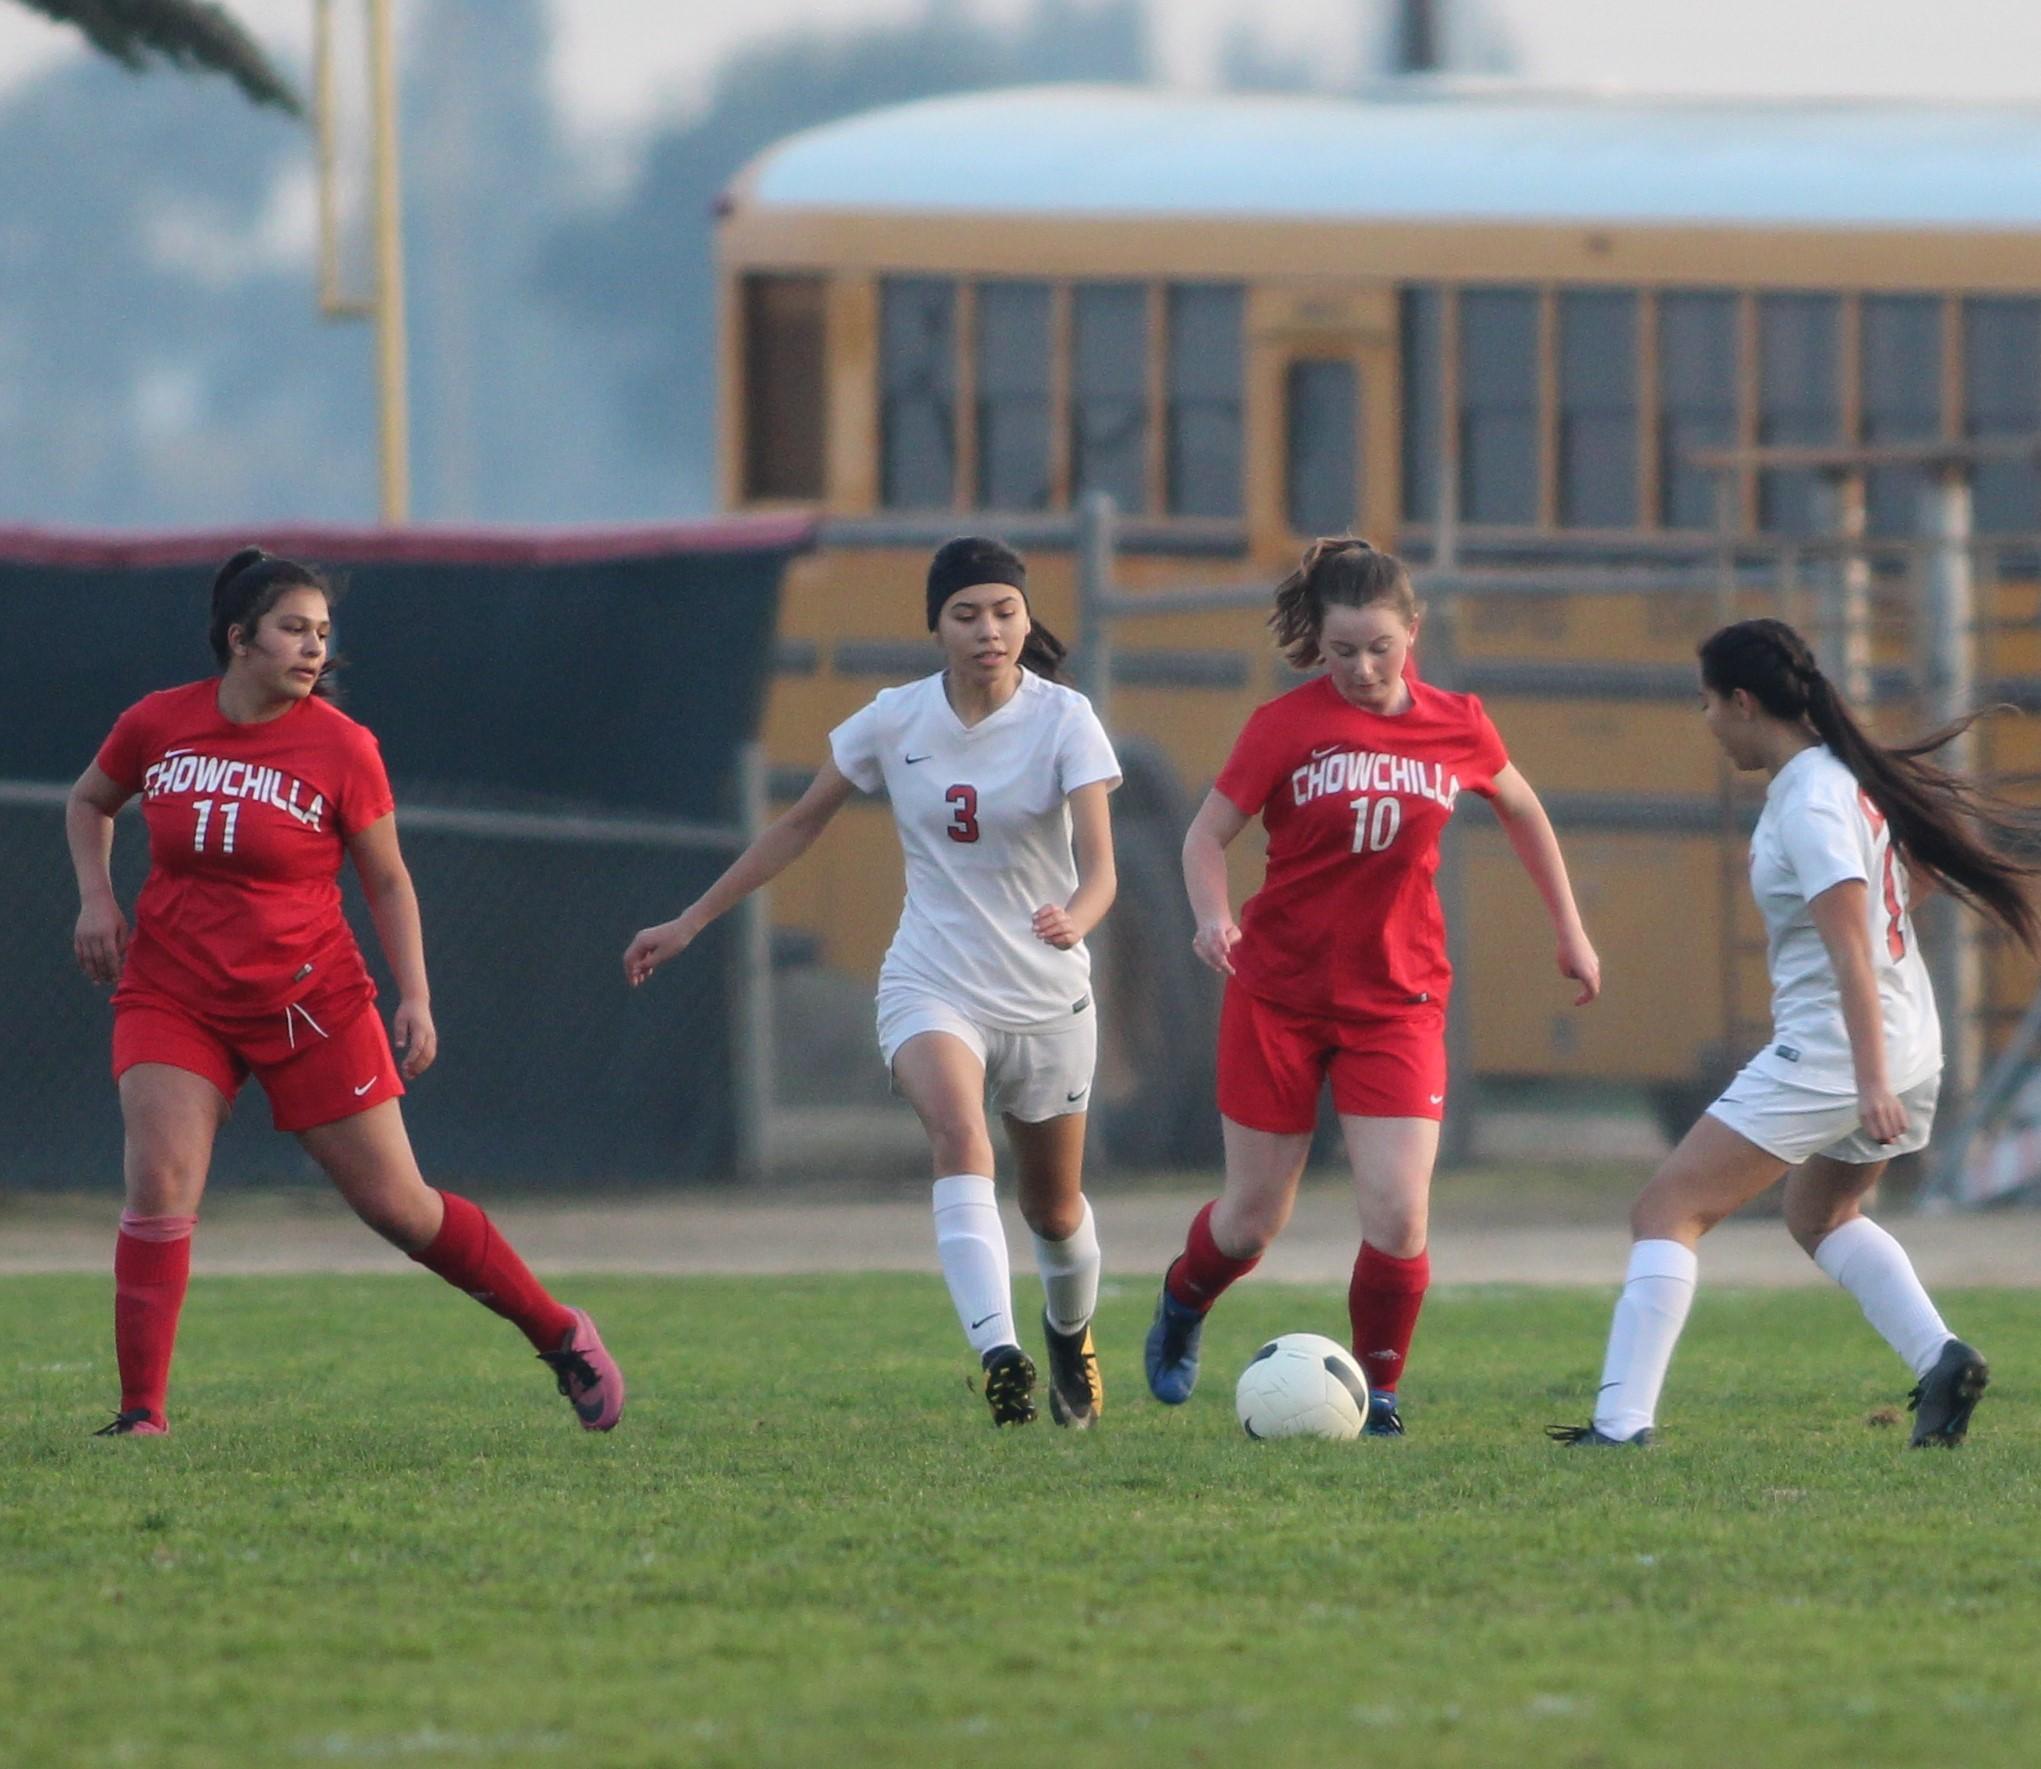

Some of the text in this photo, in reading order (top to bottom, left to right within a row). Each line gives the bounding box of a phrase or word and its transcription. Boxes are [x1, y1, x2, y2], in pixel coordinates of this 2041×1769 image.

[144, 755, 323, 833] CHOWCHILLA
[945, 783, 980, 843] 3
[192, 799, 240, 854] 11
[1350, 796, 1401, 854] 10
